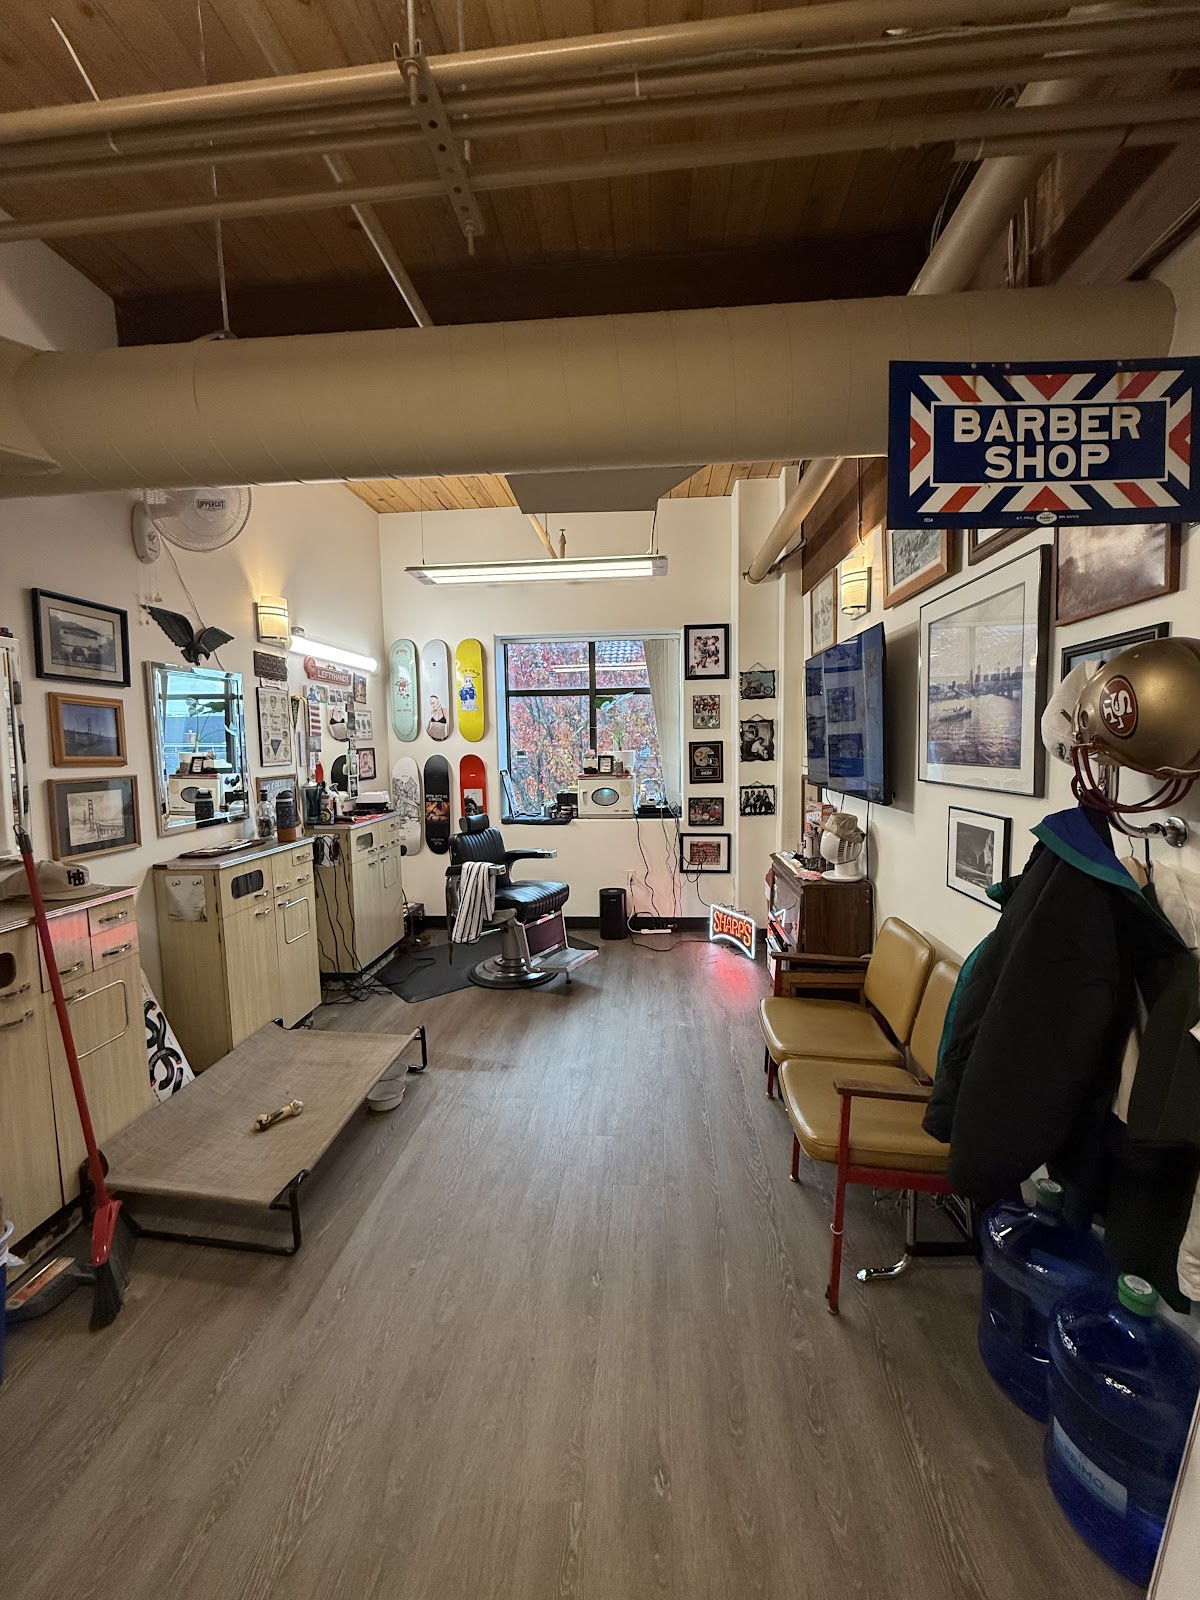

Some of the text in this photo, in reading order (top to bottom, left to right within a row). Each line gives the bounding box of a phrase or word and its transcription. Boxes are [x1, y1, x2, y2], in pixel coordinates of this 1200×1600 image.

[954, 406, 1142, 443] BARBER
[984, 443, 1110, 479] SHOP
[197, 500, 224, 509] UPPERCUT
[317, 669, 350, 683] LEFTYHANDS
[713, 909, 752, 947] SHARP'S
[1064, 1445, 1105, 1492] PRIMO
